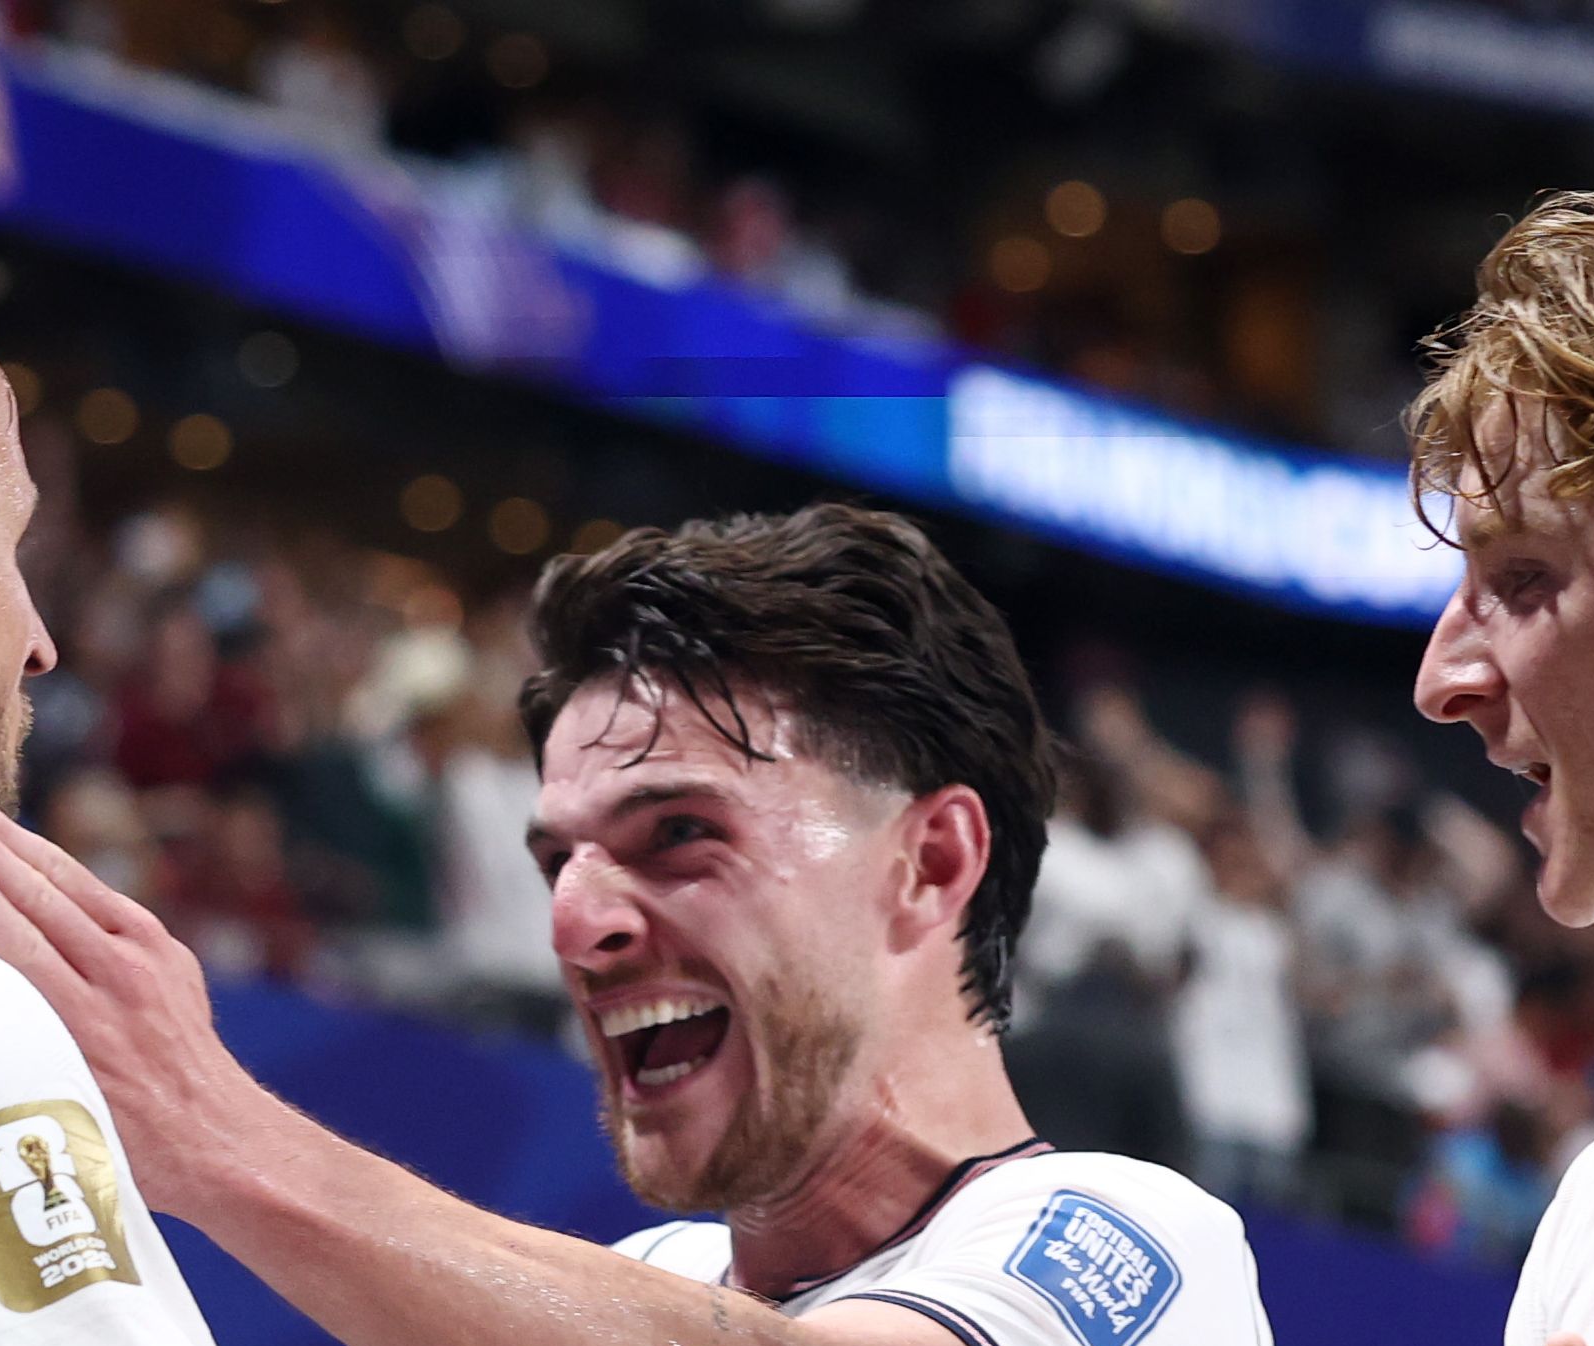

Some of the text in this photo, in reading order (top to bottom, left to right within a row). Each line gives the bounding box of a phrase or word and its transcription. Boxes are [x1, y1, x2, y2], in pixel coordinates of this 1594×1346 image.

[46, 1210, 83, 1231] FIFA
[1074, 1207, 1157, 1287] FOOTBALL
[1043, 1239, 1137, 1335] the World
[1060, 1277, 1096, 1319] FIFA
[1063, 1217, 1149, 1307] UNITES
